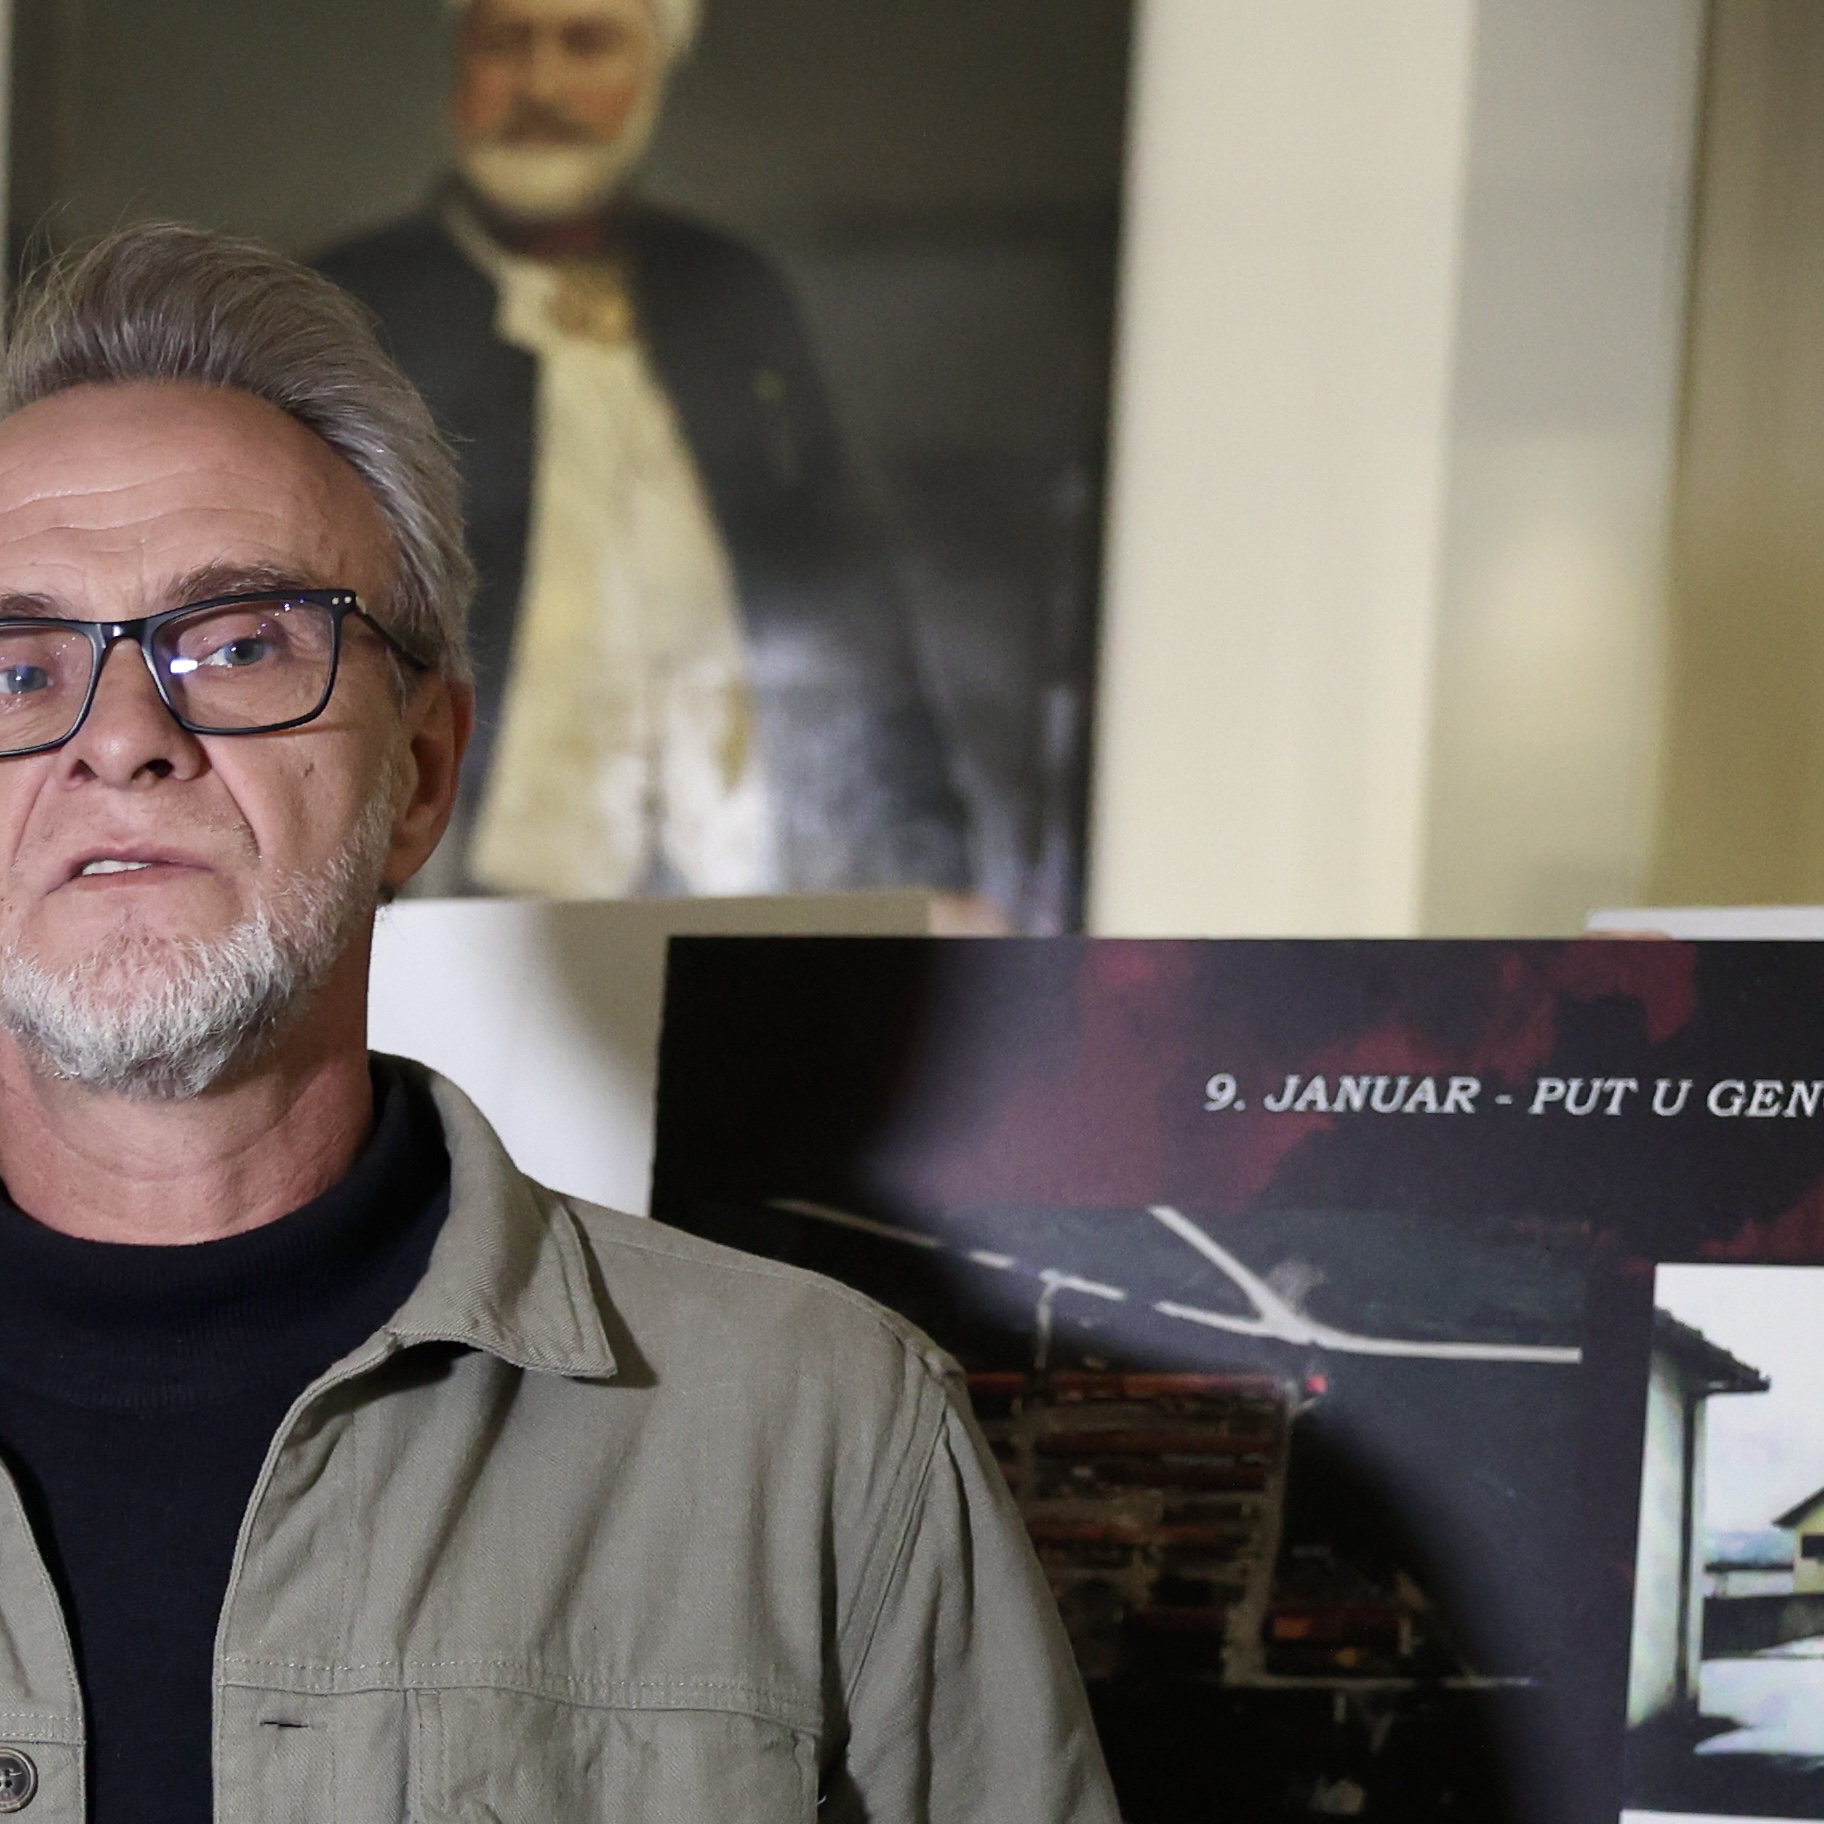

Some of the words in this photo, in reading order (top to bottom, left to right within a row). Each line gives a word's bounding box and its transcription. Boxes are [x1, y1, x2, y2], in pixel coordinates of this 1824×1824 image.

[1202, 1072, 1246, 1112] 9.
[1263, 1074, 1484, 1115] JANUAR
[1528, 1077, 1639, 1117] PUT
[1650, 1078, 1693, 1117] U
[1705, 1079, 1824, 1118] GEN
